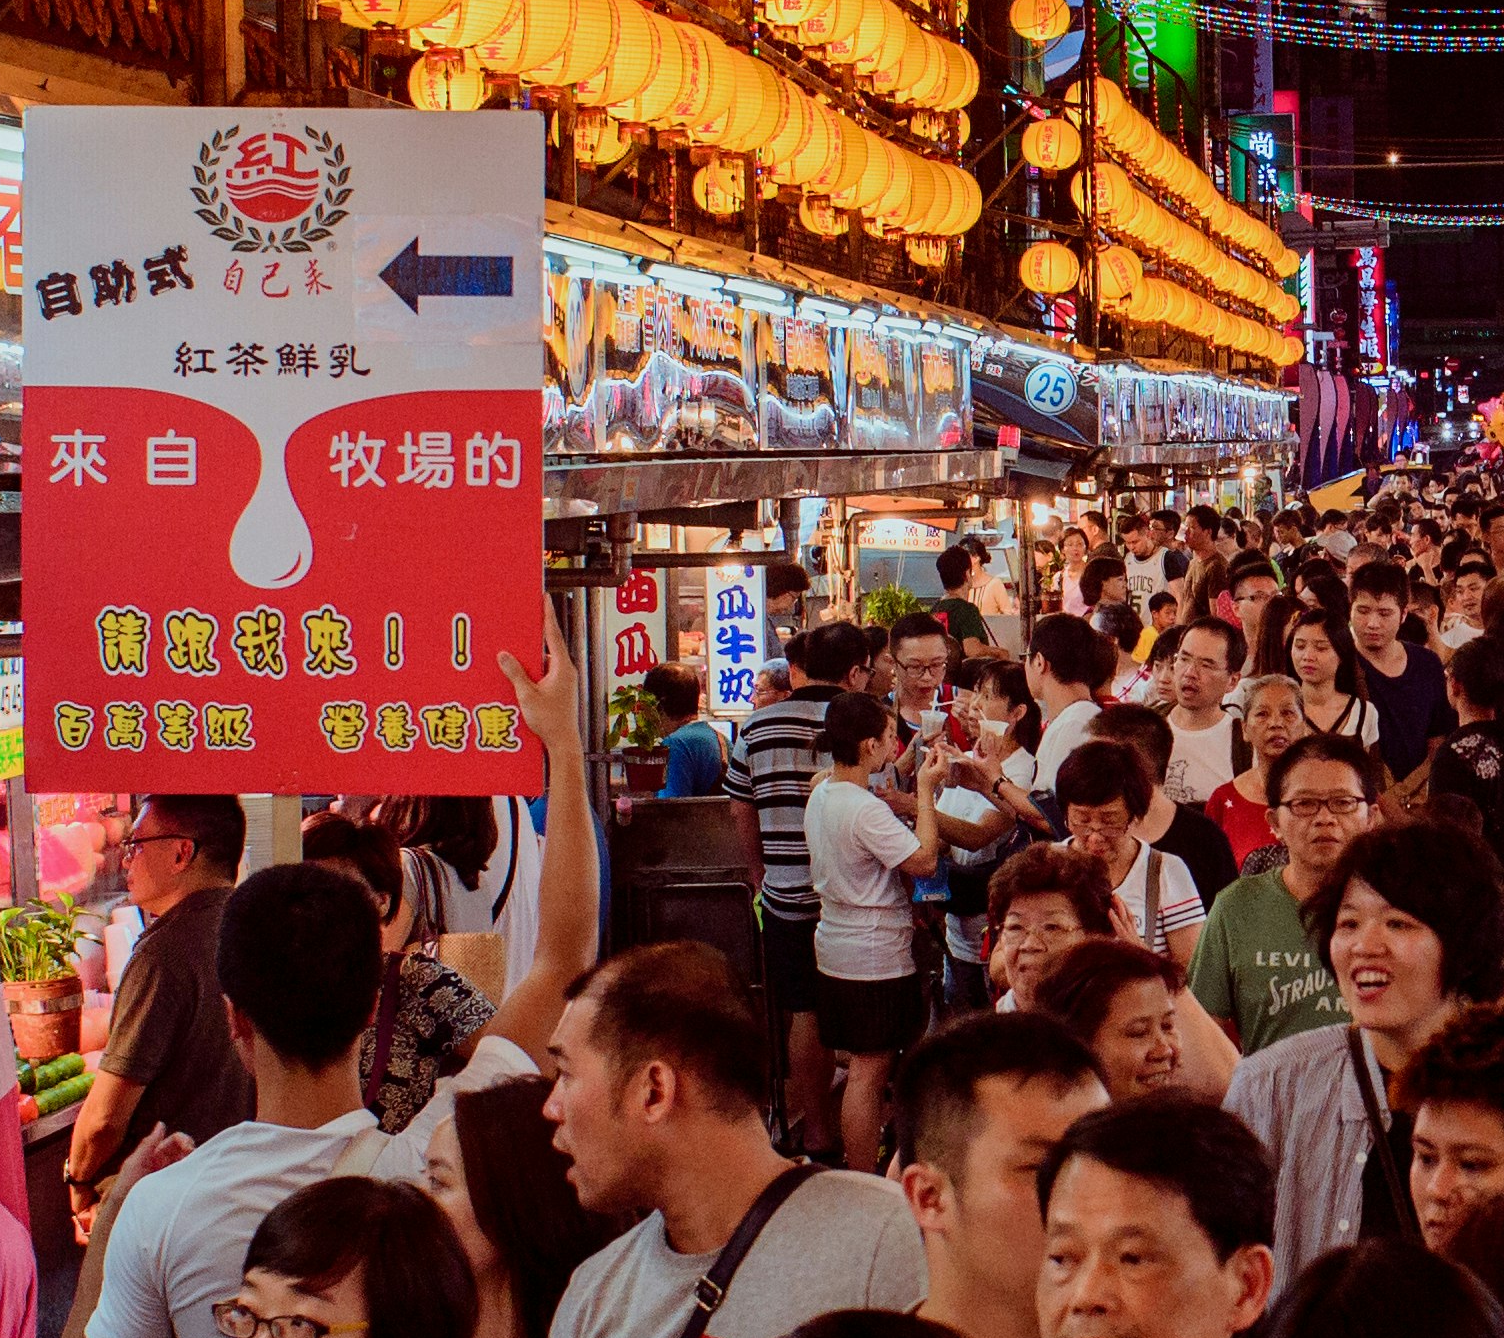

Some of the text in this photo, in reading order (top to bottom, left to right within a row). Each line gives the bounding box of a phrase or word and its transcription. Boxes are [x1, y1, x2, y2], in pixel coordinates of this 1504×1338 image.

[35, 244, 196, 320] 自助式
[173, 341, 372, 378] 紅茶鮮乳
[1034, 372, 1067, 405] 25
[328, 430, 523, 490] 牧場的
[715, 566, 756, 704] 瓜牛奶
[54, 703, 522, 753] 百萬等級 營養健康
